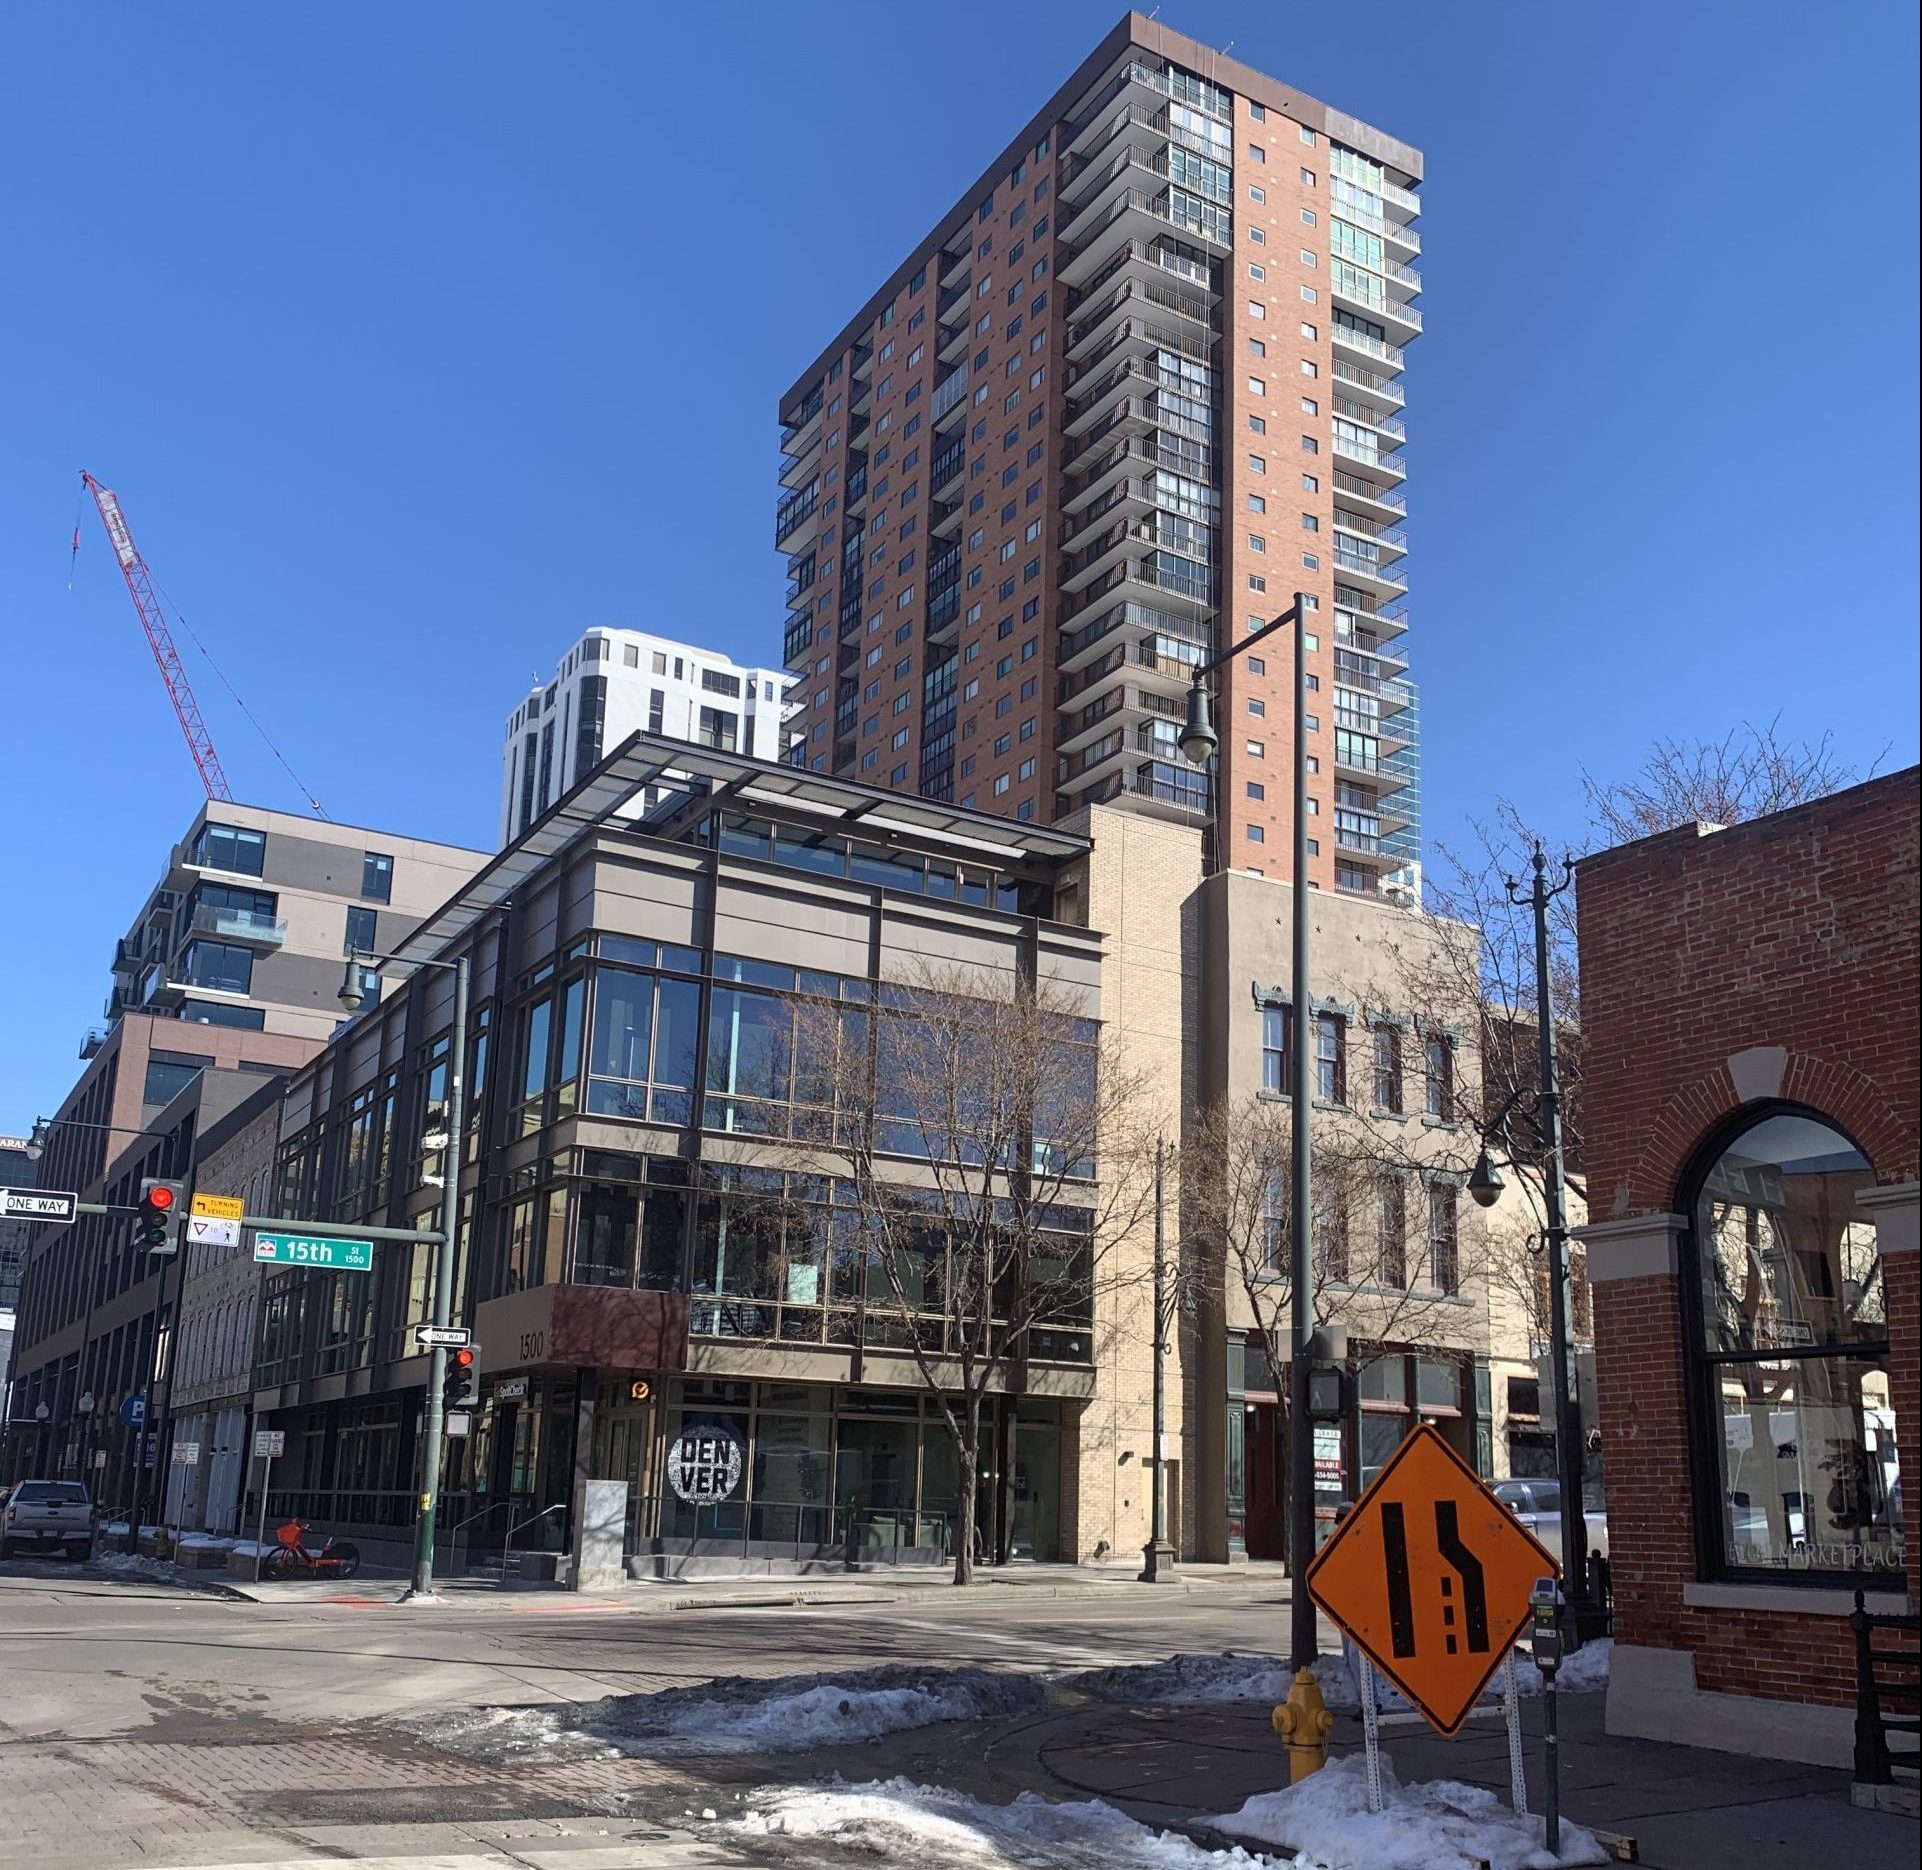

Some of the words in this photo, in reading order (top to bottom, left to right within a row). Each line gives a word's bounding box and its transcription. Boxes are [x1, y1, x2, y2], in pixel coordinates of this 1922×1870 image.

[7, 1197, 33, 1210] ONE
[38, 1199, 64, 1213] WAY
[210, 1200, 239, 1209] TURNING
[207, 1208, 240, 1218] VEHICLES
[287, 1240, 333, 1263] 15th
[351, 1246, 360, 1255] St
[344, 1254, 365, 1265] 1500
[431, 1331, 446, 1341] ONE
[448, 1333, 463, 1343] WAY
[519, 1331, 544, 1361] 1500
[681, 1438, 731, 1465] DEN
[680, 1466, 728, 1494] VER
[1779, 1541, 1908, 1568] MARKETPLACE
